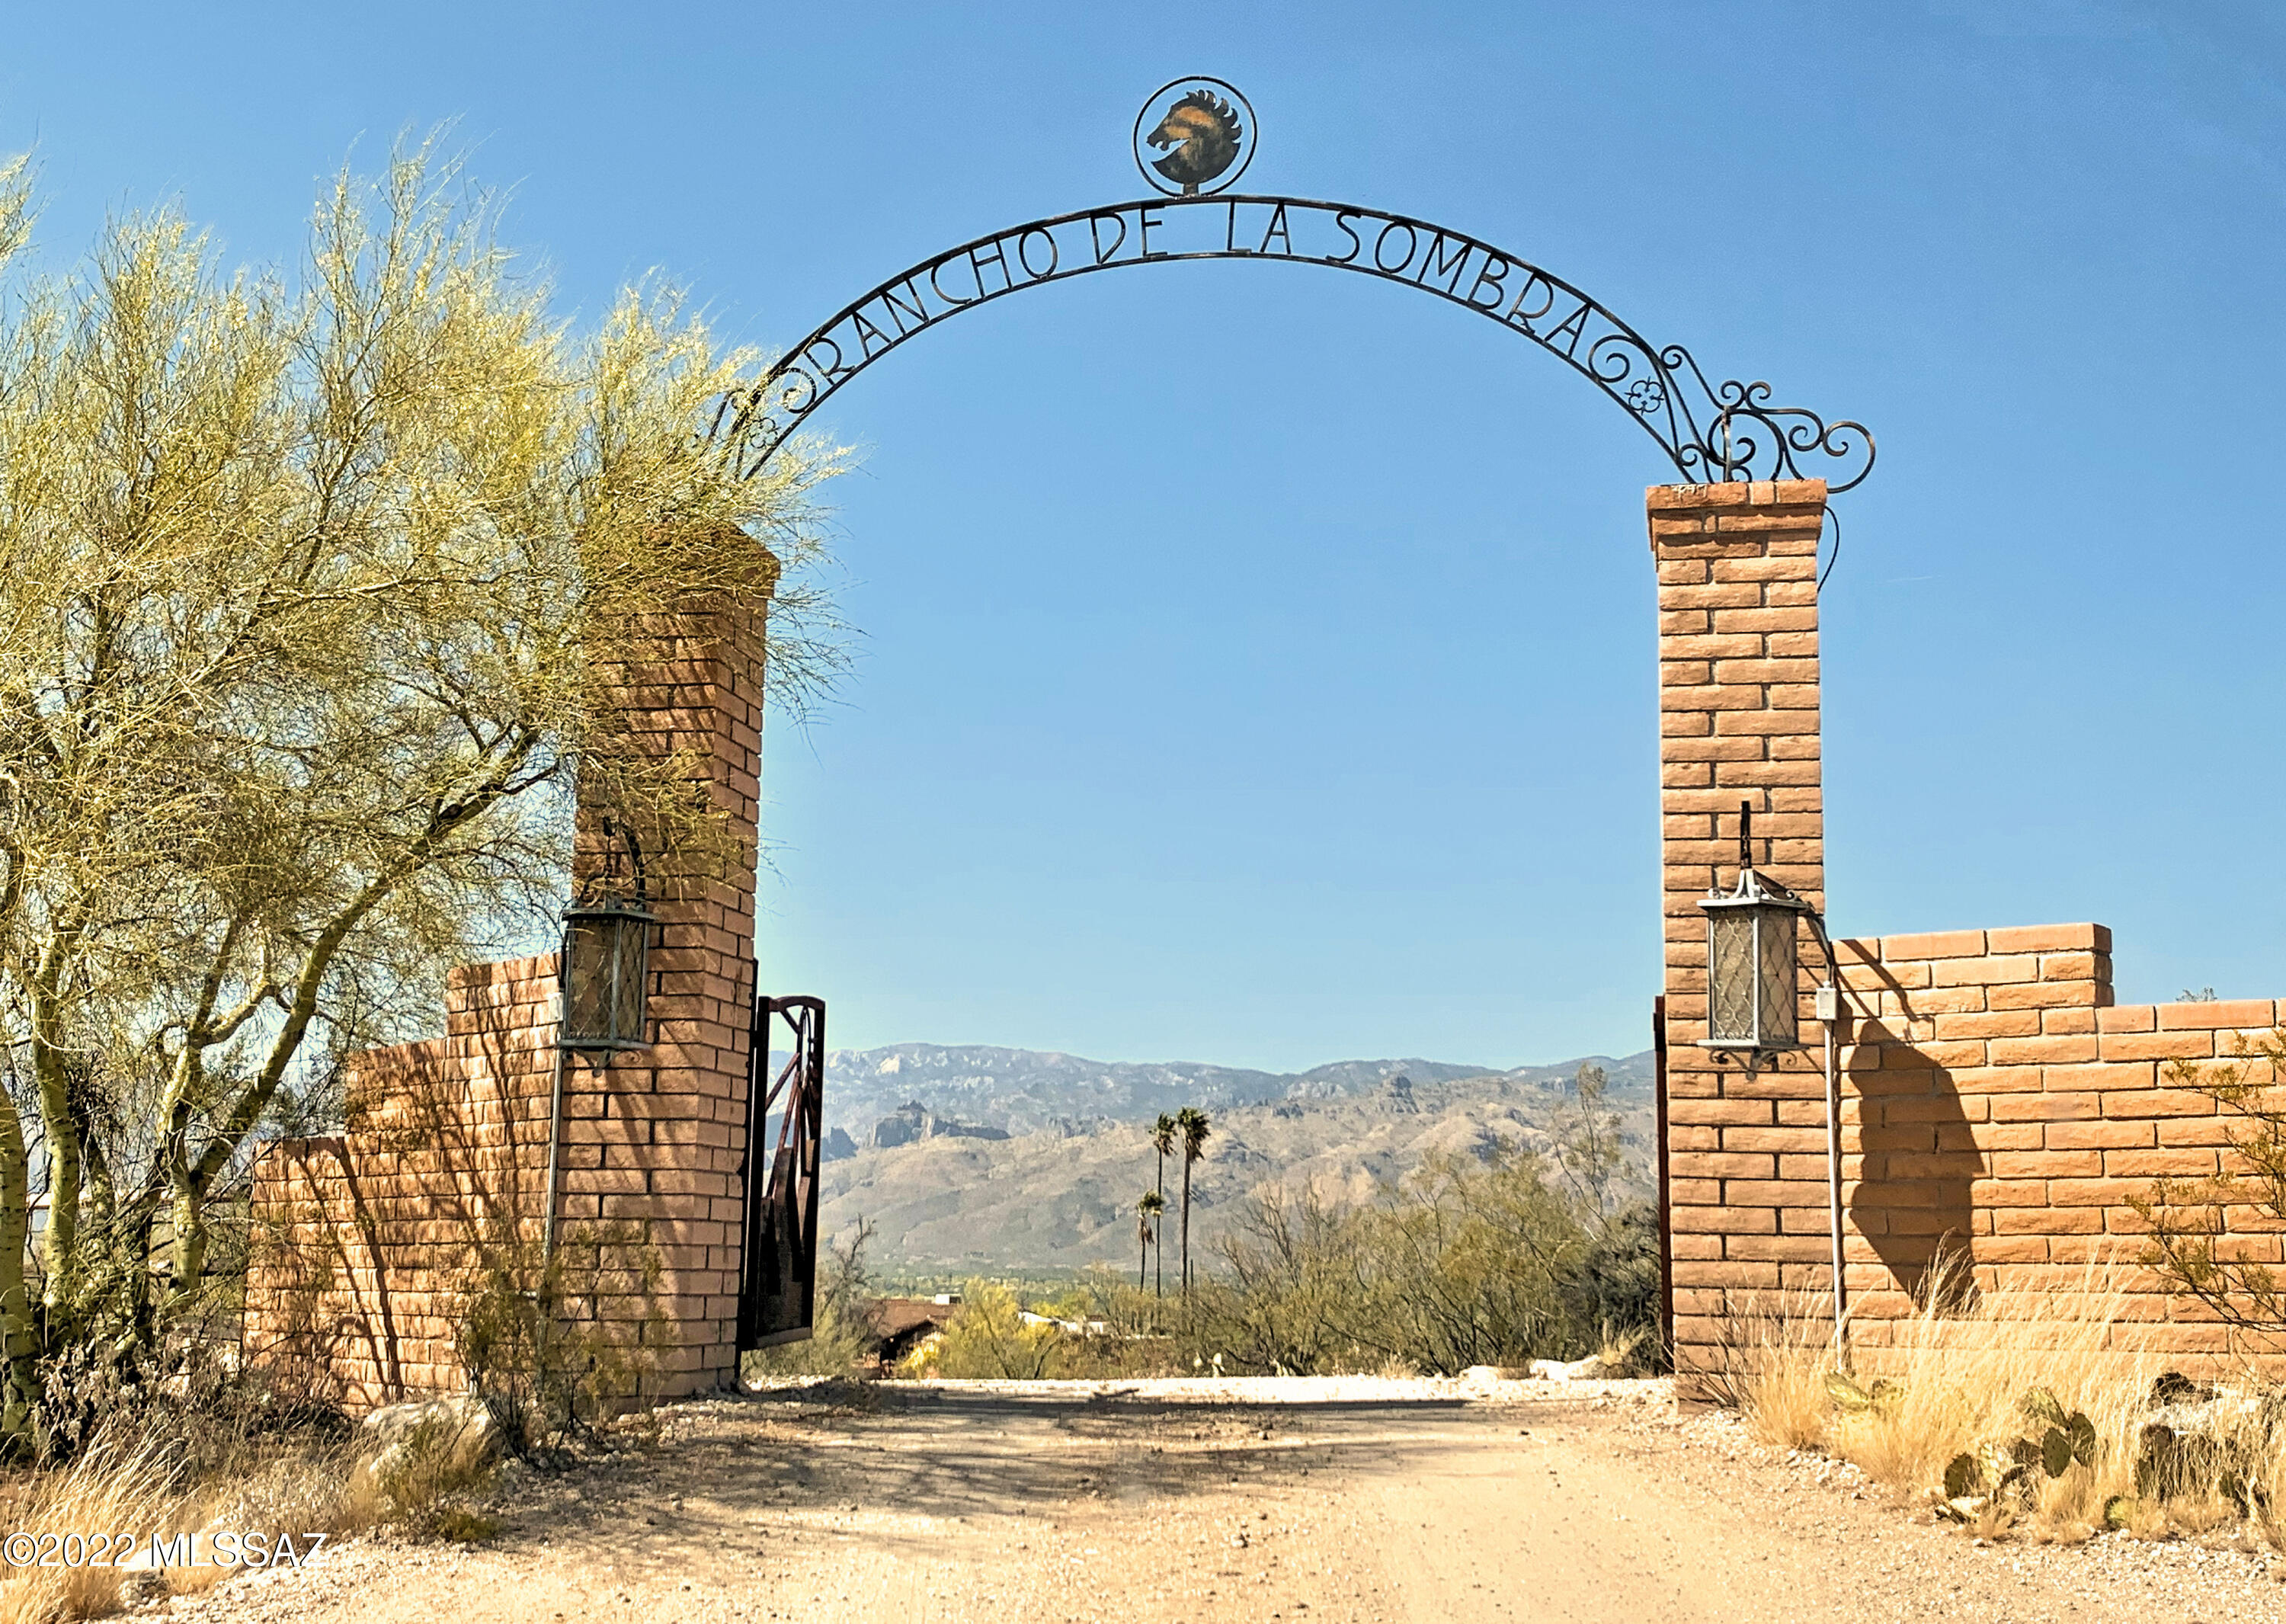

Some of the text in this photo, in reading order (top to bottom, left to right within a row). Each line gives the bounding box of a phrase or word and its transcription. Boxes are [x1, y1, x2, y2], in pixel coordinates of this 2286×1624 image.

[803, 198, 1593, 386] RANCHO DE LA SOMBRA
